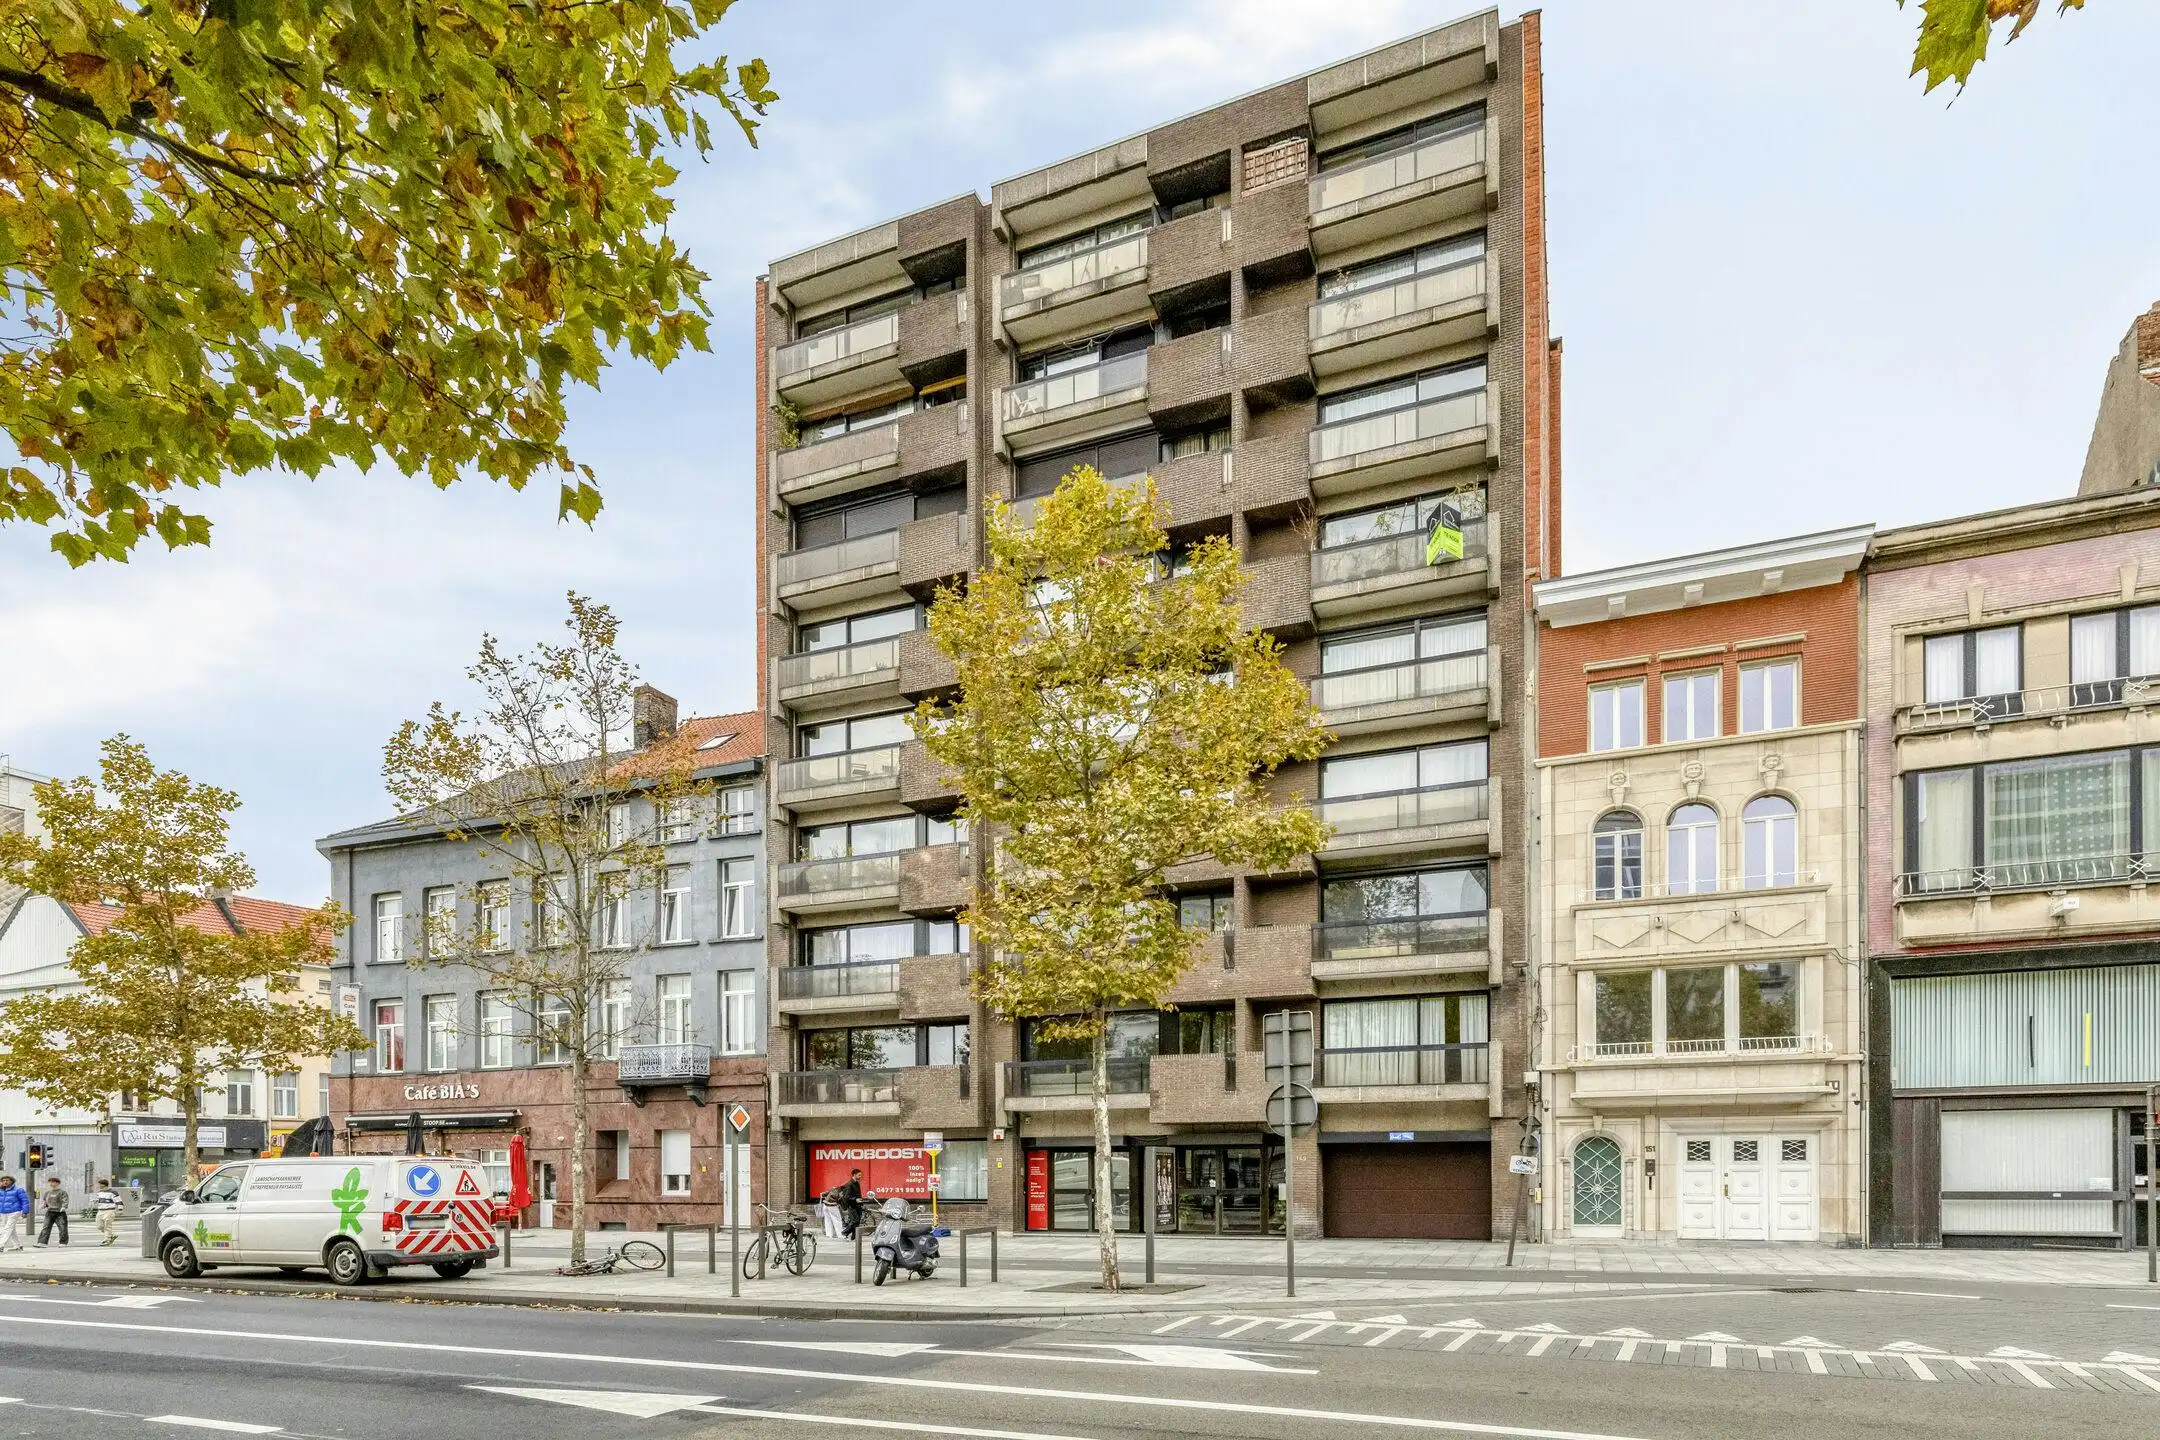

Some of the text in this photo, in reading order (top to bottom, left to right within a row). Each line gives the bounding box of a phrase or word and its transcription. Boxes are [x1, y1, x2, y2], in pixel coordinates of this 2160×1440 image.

[404, 1084, 437, 1100] Café
[815, 1147, 925, 1160] IMMOBOOST
[1645, 1145, 1656, 1153] 151
